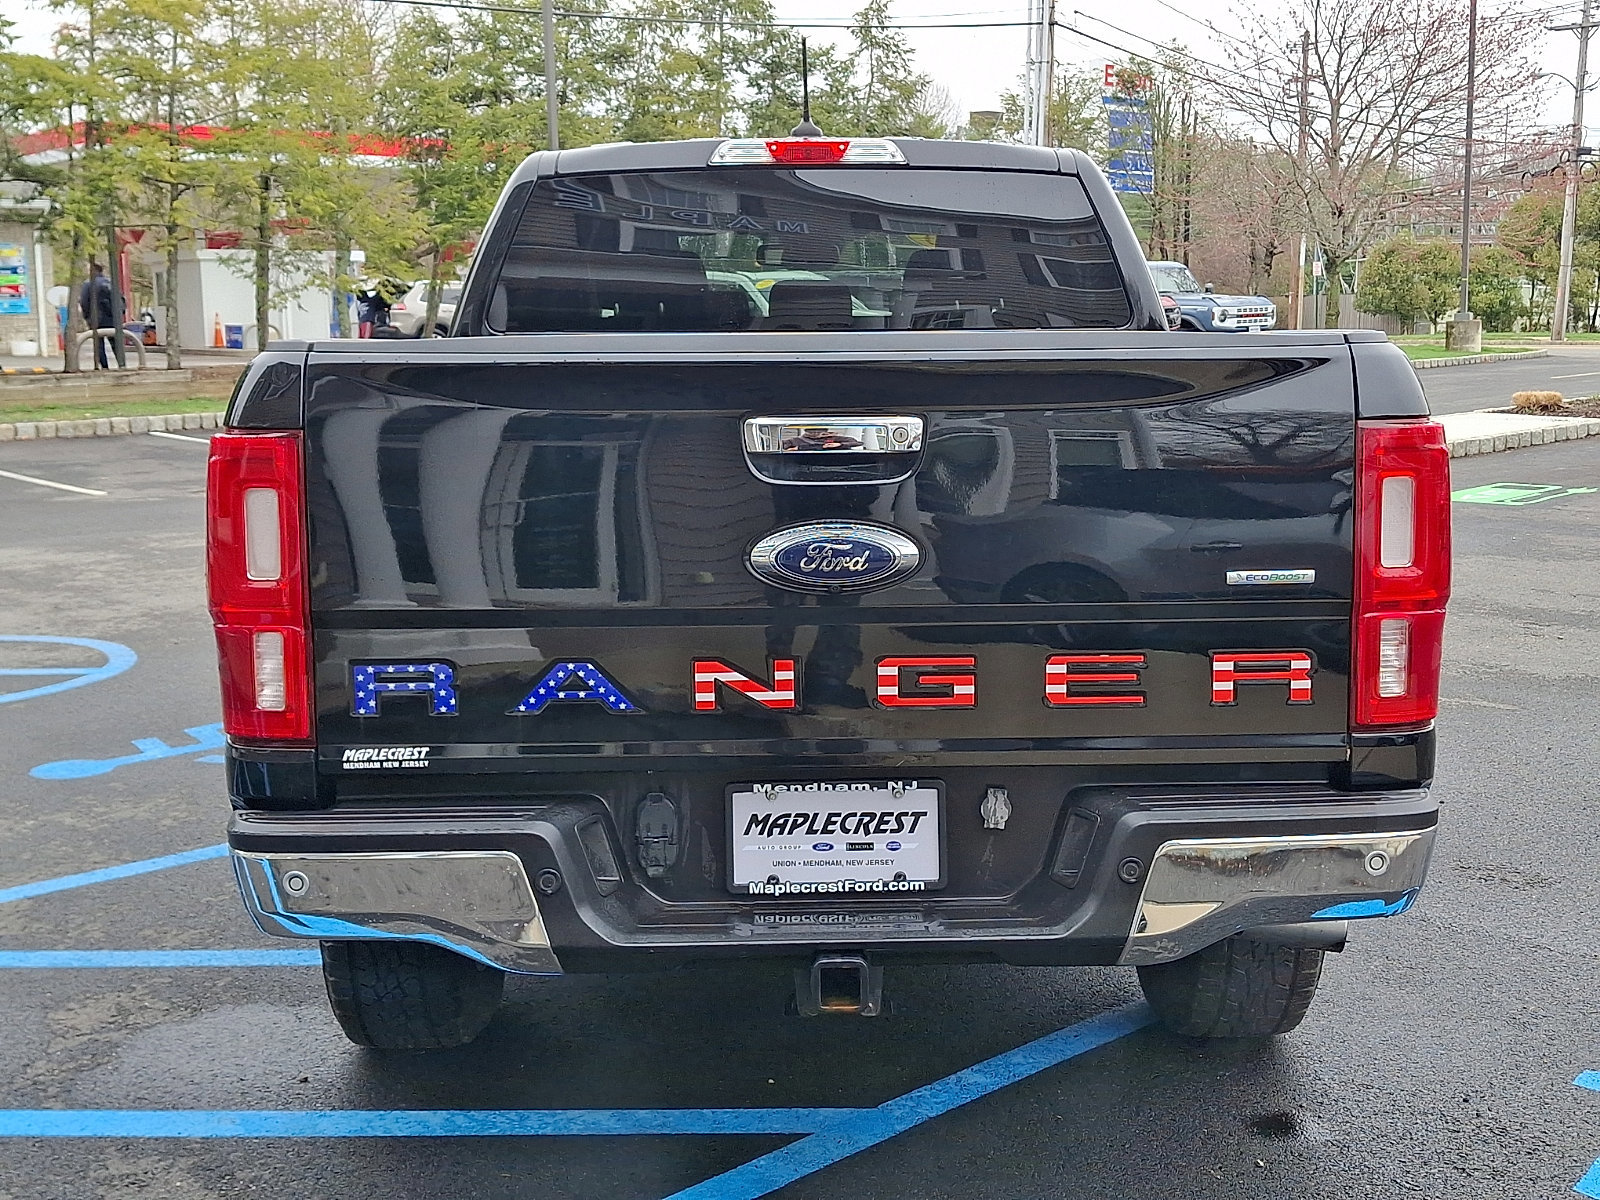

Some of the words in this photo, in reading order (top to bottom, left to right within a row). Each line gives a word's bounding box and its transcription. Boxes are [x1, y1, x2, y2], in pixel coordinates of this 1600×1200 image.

[800, 542, 869, 572] Ford
[351, 651, 1314, 716] RANGER
[342, 747, 430, 762] MAPLECREST
[343, 761, 380, 769] MENDHAM
[401, 760, 429, 768] JERSEY
[743, 811, 927, 838] MAPLECREST
[803, 859, 844, 868] MENDHAM,
[749, 880, 925, 896] MaplecrestFord.com
